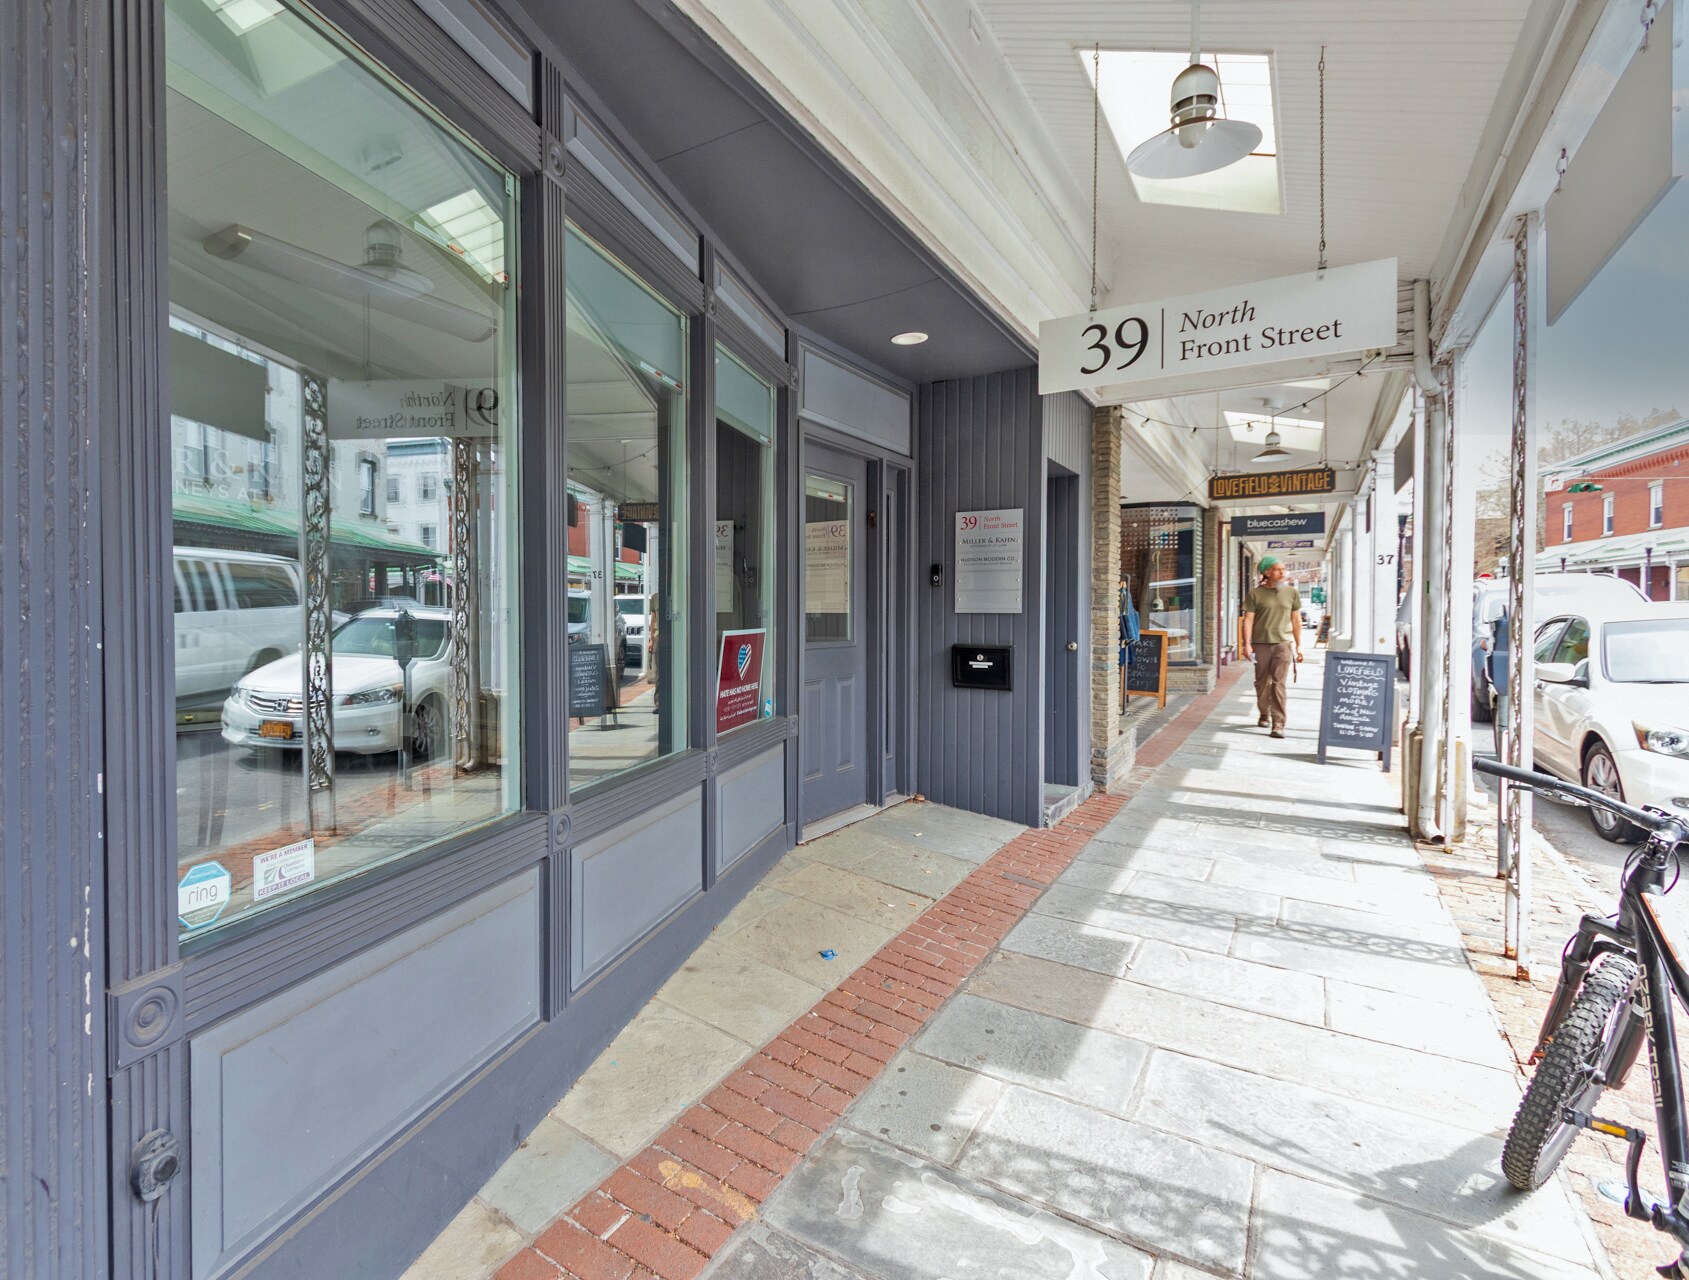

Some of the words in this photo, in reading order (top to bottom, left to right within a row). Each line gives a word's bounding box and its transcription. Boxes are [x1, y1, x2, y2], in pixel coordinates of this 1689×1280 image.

[1178, 300, 1256, 333] North
[1080, 317, 1149, 375] 39
[1179, 334, 1252, 361] Front
[1261, 319, 1342, 350] Street
[1213, 476, 1268, 497] LOVEFIELD
[1280, 471, 1332, 493] VINTAGE
[960, 516, 977, 531] 39
[1247, 517, 1307, 528] bluecashew
[1376, 554, 1395, 565] 37
[1337, 664, 1384, 677] LOVEFIELD
[1337, 686, 1379, 697] CLOTHING
[1340, 678, 1379, 691] Vintage
[284, 843, 308, 855] MEMBER
[188, 884, 218, 905] ring
